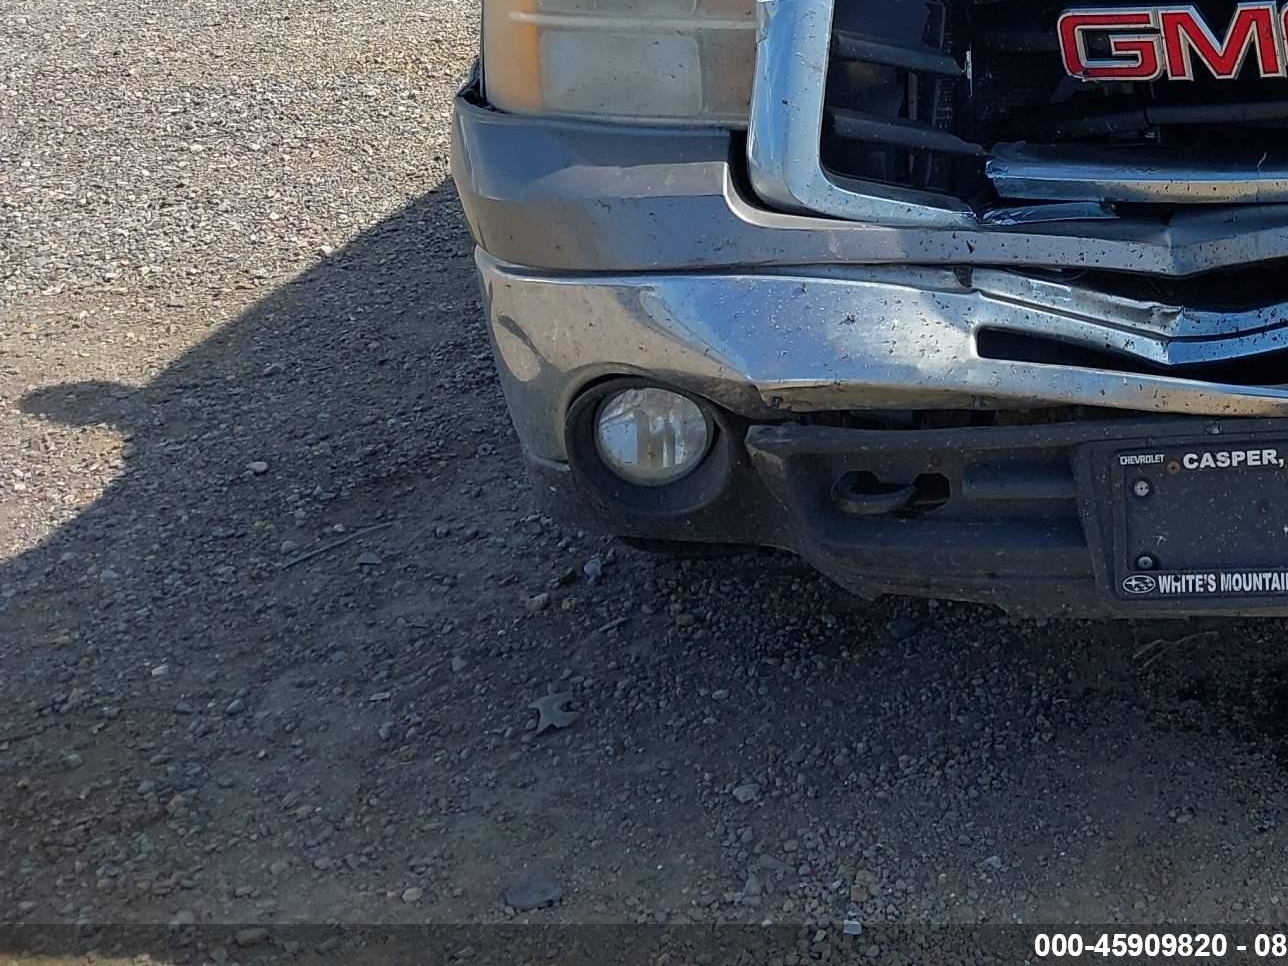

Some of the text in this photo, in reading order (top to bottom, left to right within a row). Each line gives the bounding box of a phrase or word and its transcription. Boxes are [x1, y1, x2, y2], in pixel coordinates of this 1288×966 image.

[1119, 454, 1165, 465] CHEVROLET
[1183, 449, 1285, 470] CASPER,
[1158, 574, 1217, 593] WHITE'S
